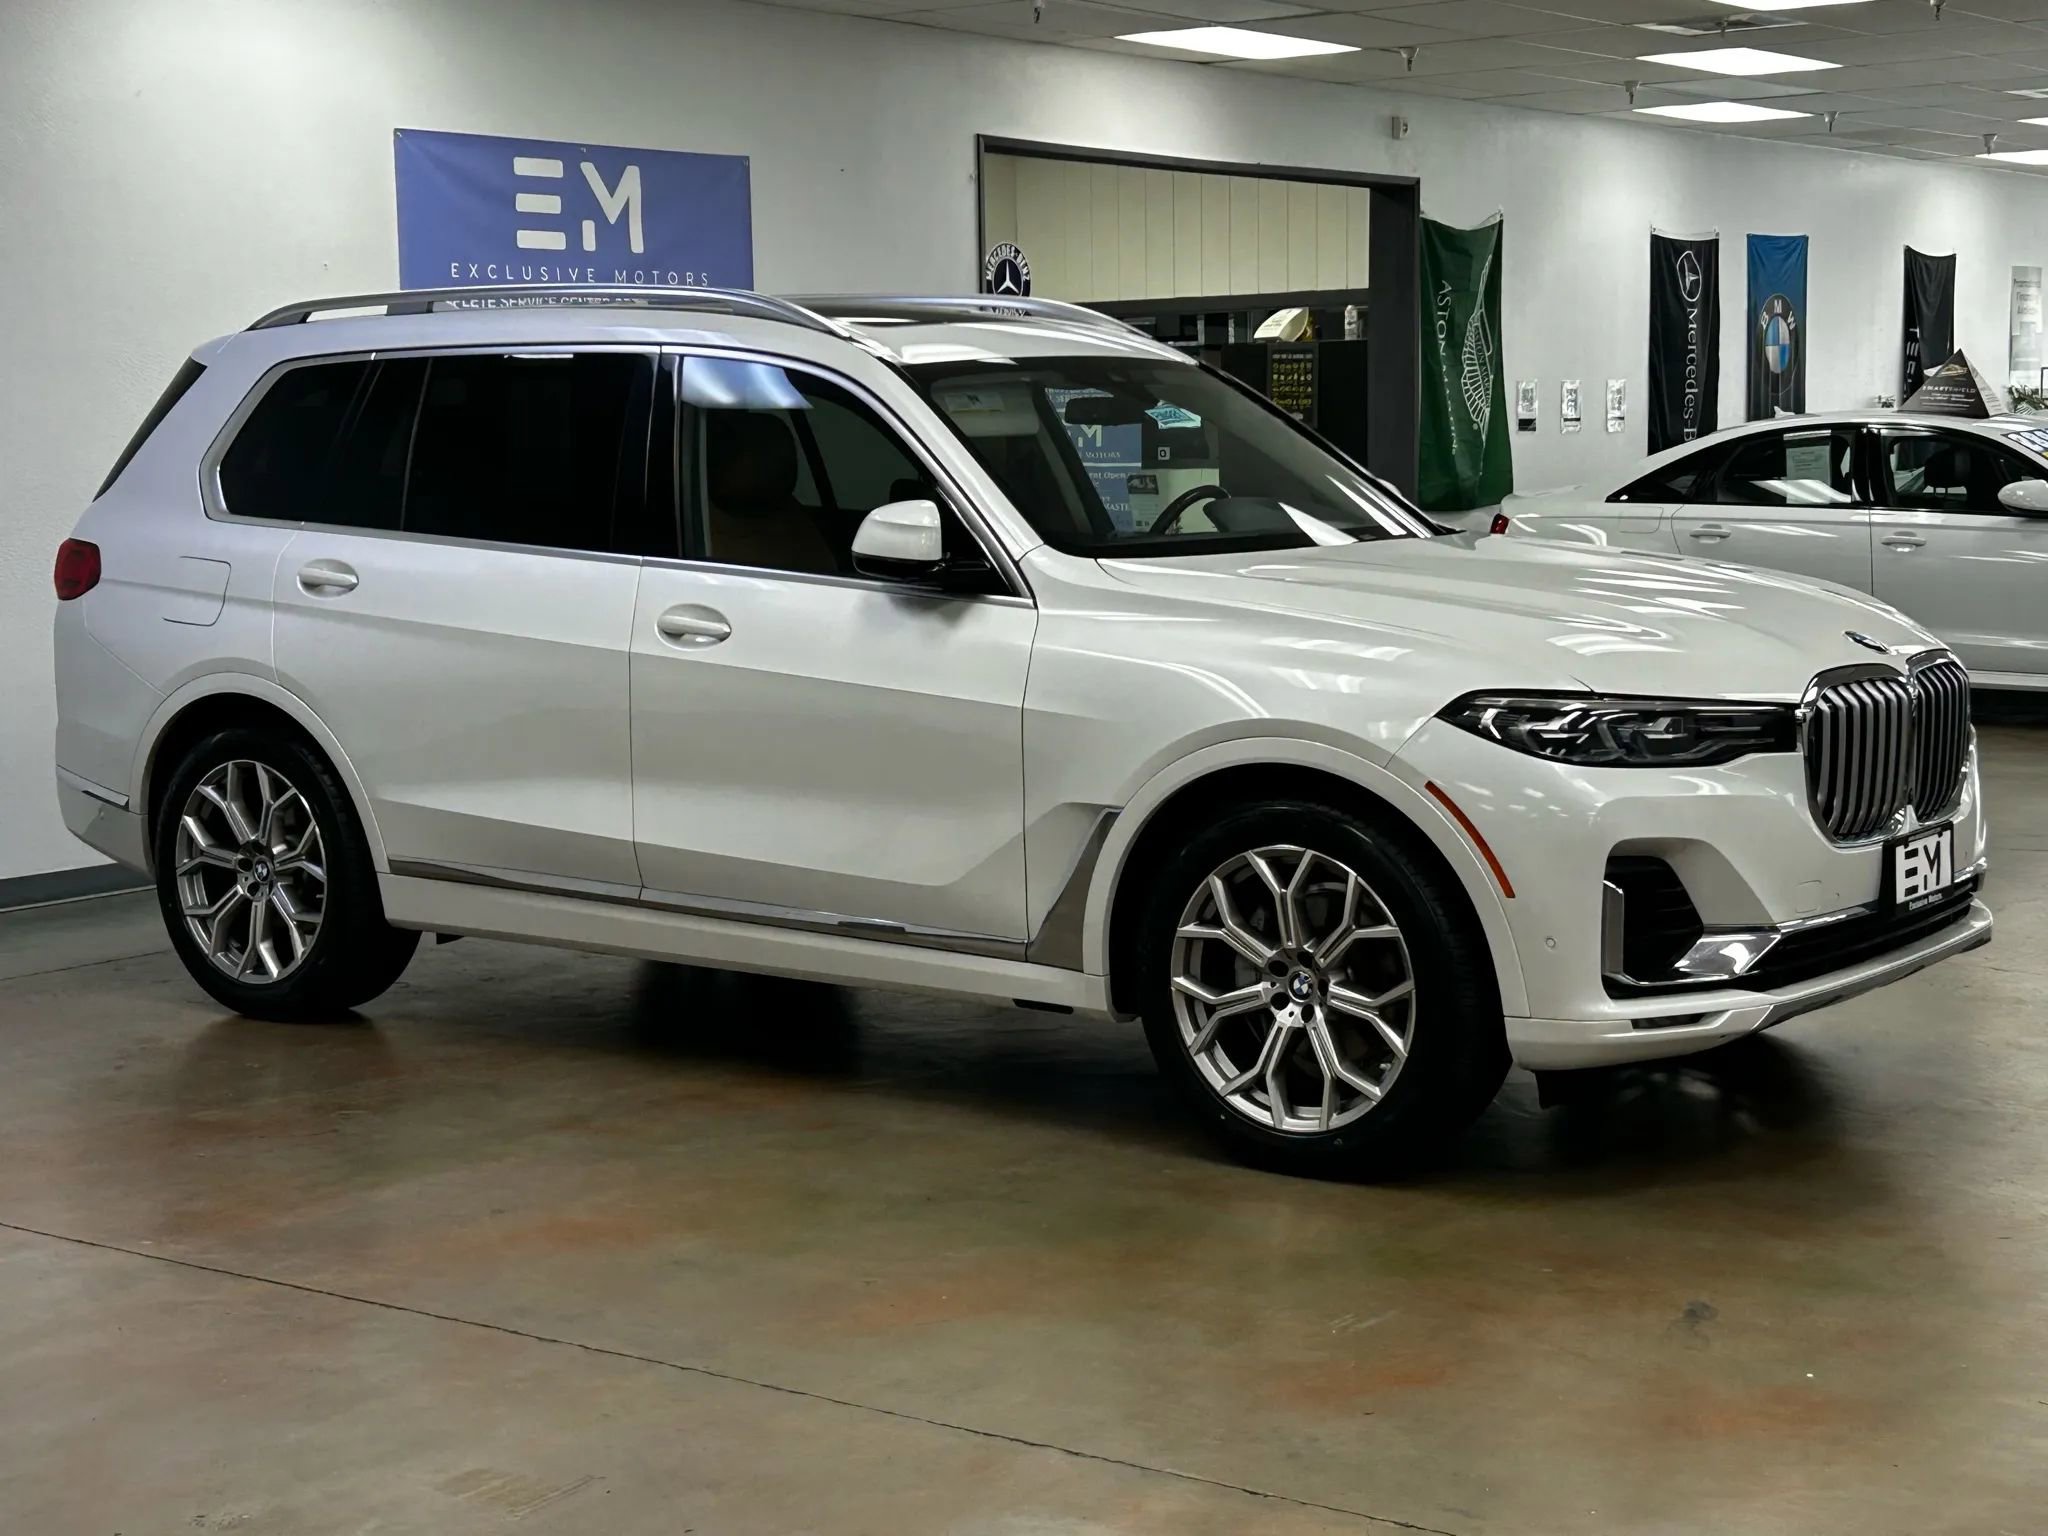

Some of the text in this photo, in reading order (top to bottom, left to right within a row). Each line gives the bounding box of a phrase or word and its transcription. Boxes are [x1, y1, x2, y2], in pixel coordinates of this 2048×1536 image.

[513, 156, 644, 254] EM
[451, 263, 708, 286] EXCLUSIVE MOTORS
[1436, 279, 1452, 356] ASTON
[1760, 299, 1797, 331] BMW
[1904, 841, 1941, 897] EM
